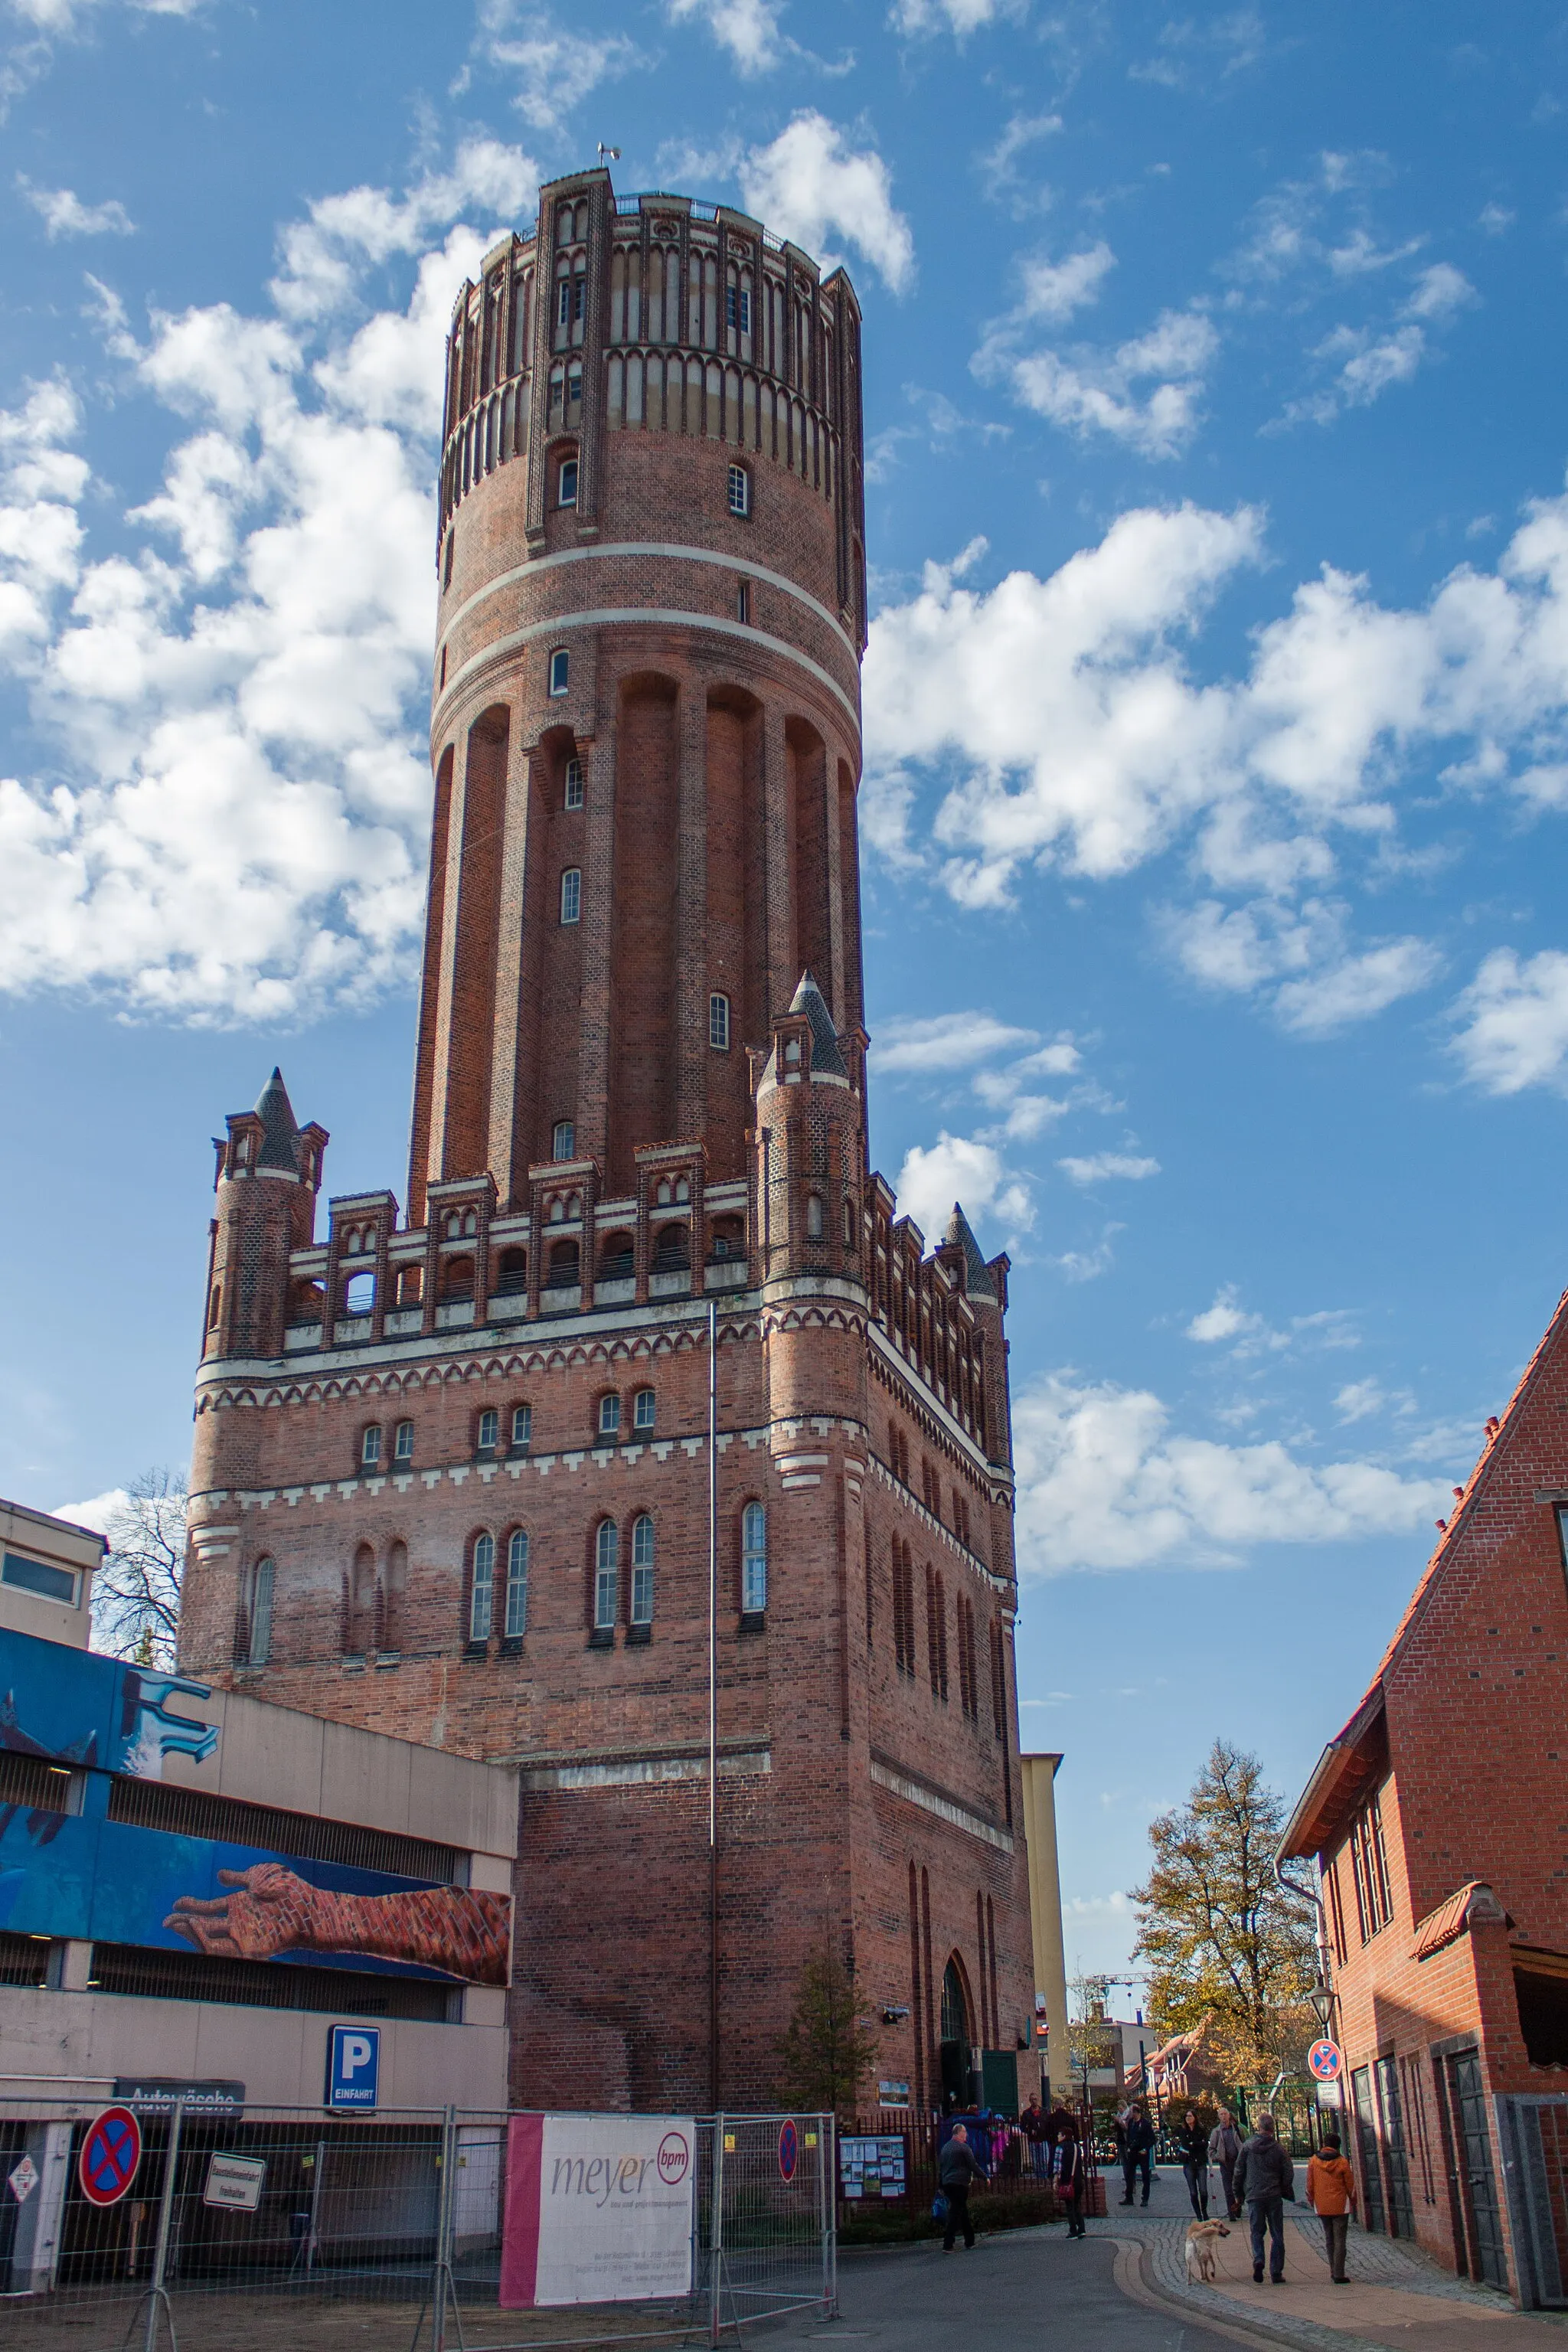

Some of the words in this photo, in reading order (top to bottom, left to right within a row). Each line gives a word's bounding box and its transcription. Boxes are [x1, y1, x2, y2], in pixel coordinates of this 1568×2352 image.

[342, 2035, 371, 2079] P
[335, 2088, 374, 2099] EINFAHRT
[661, 2149, 685, 2169] bpm
[551, 2157, 655, 2208] meyer
